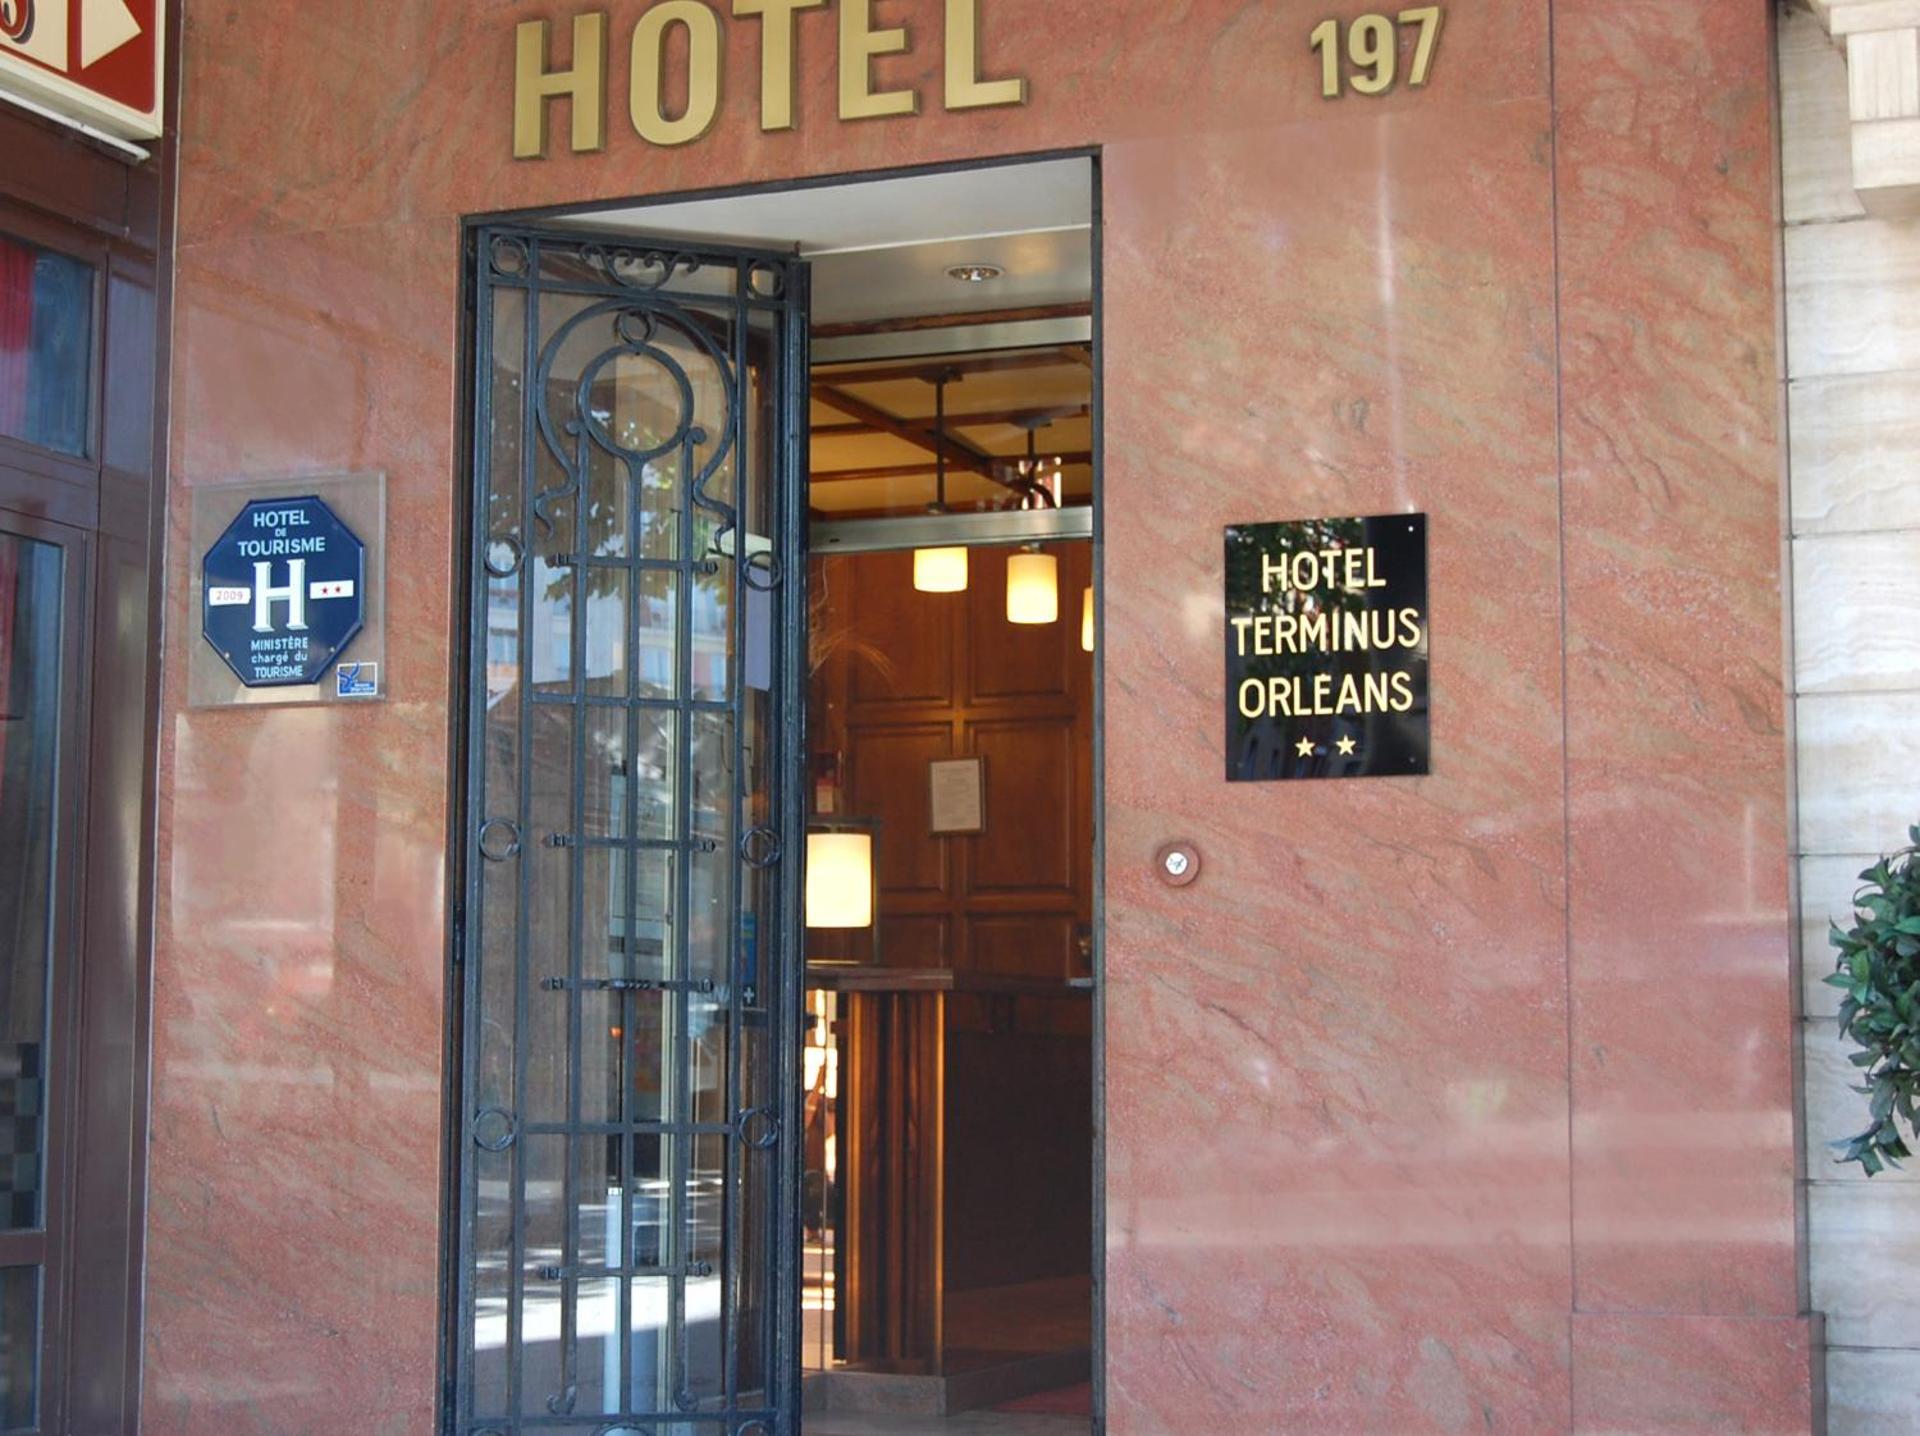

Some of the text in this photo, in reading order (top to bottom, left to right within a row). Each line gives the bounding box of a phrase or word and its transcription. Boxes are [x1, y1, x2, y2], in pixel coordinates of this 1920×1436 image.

[1310, 5, 1444, 97] 197
[513, 0, 1027, 160] HOTEL
[253, 509, 310, 527] HOTEL
[274, 527, 287, 537] DE
[237, 536, 326, 557] TOURISME
[1261, 547, 1387, 593] HOTEL
[215, 590, 244, 602] 2009
[252, 558, 309, 632] H
[1230, 607, 1422, 656] TERMINUS
[294, 650, 308, 661] du
[254, 665, 303, 678] TOURISME
